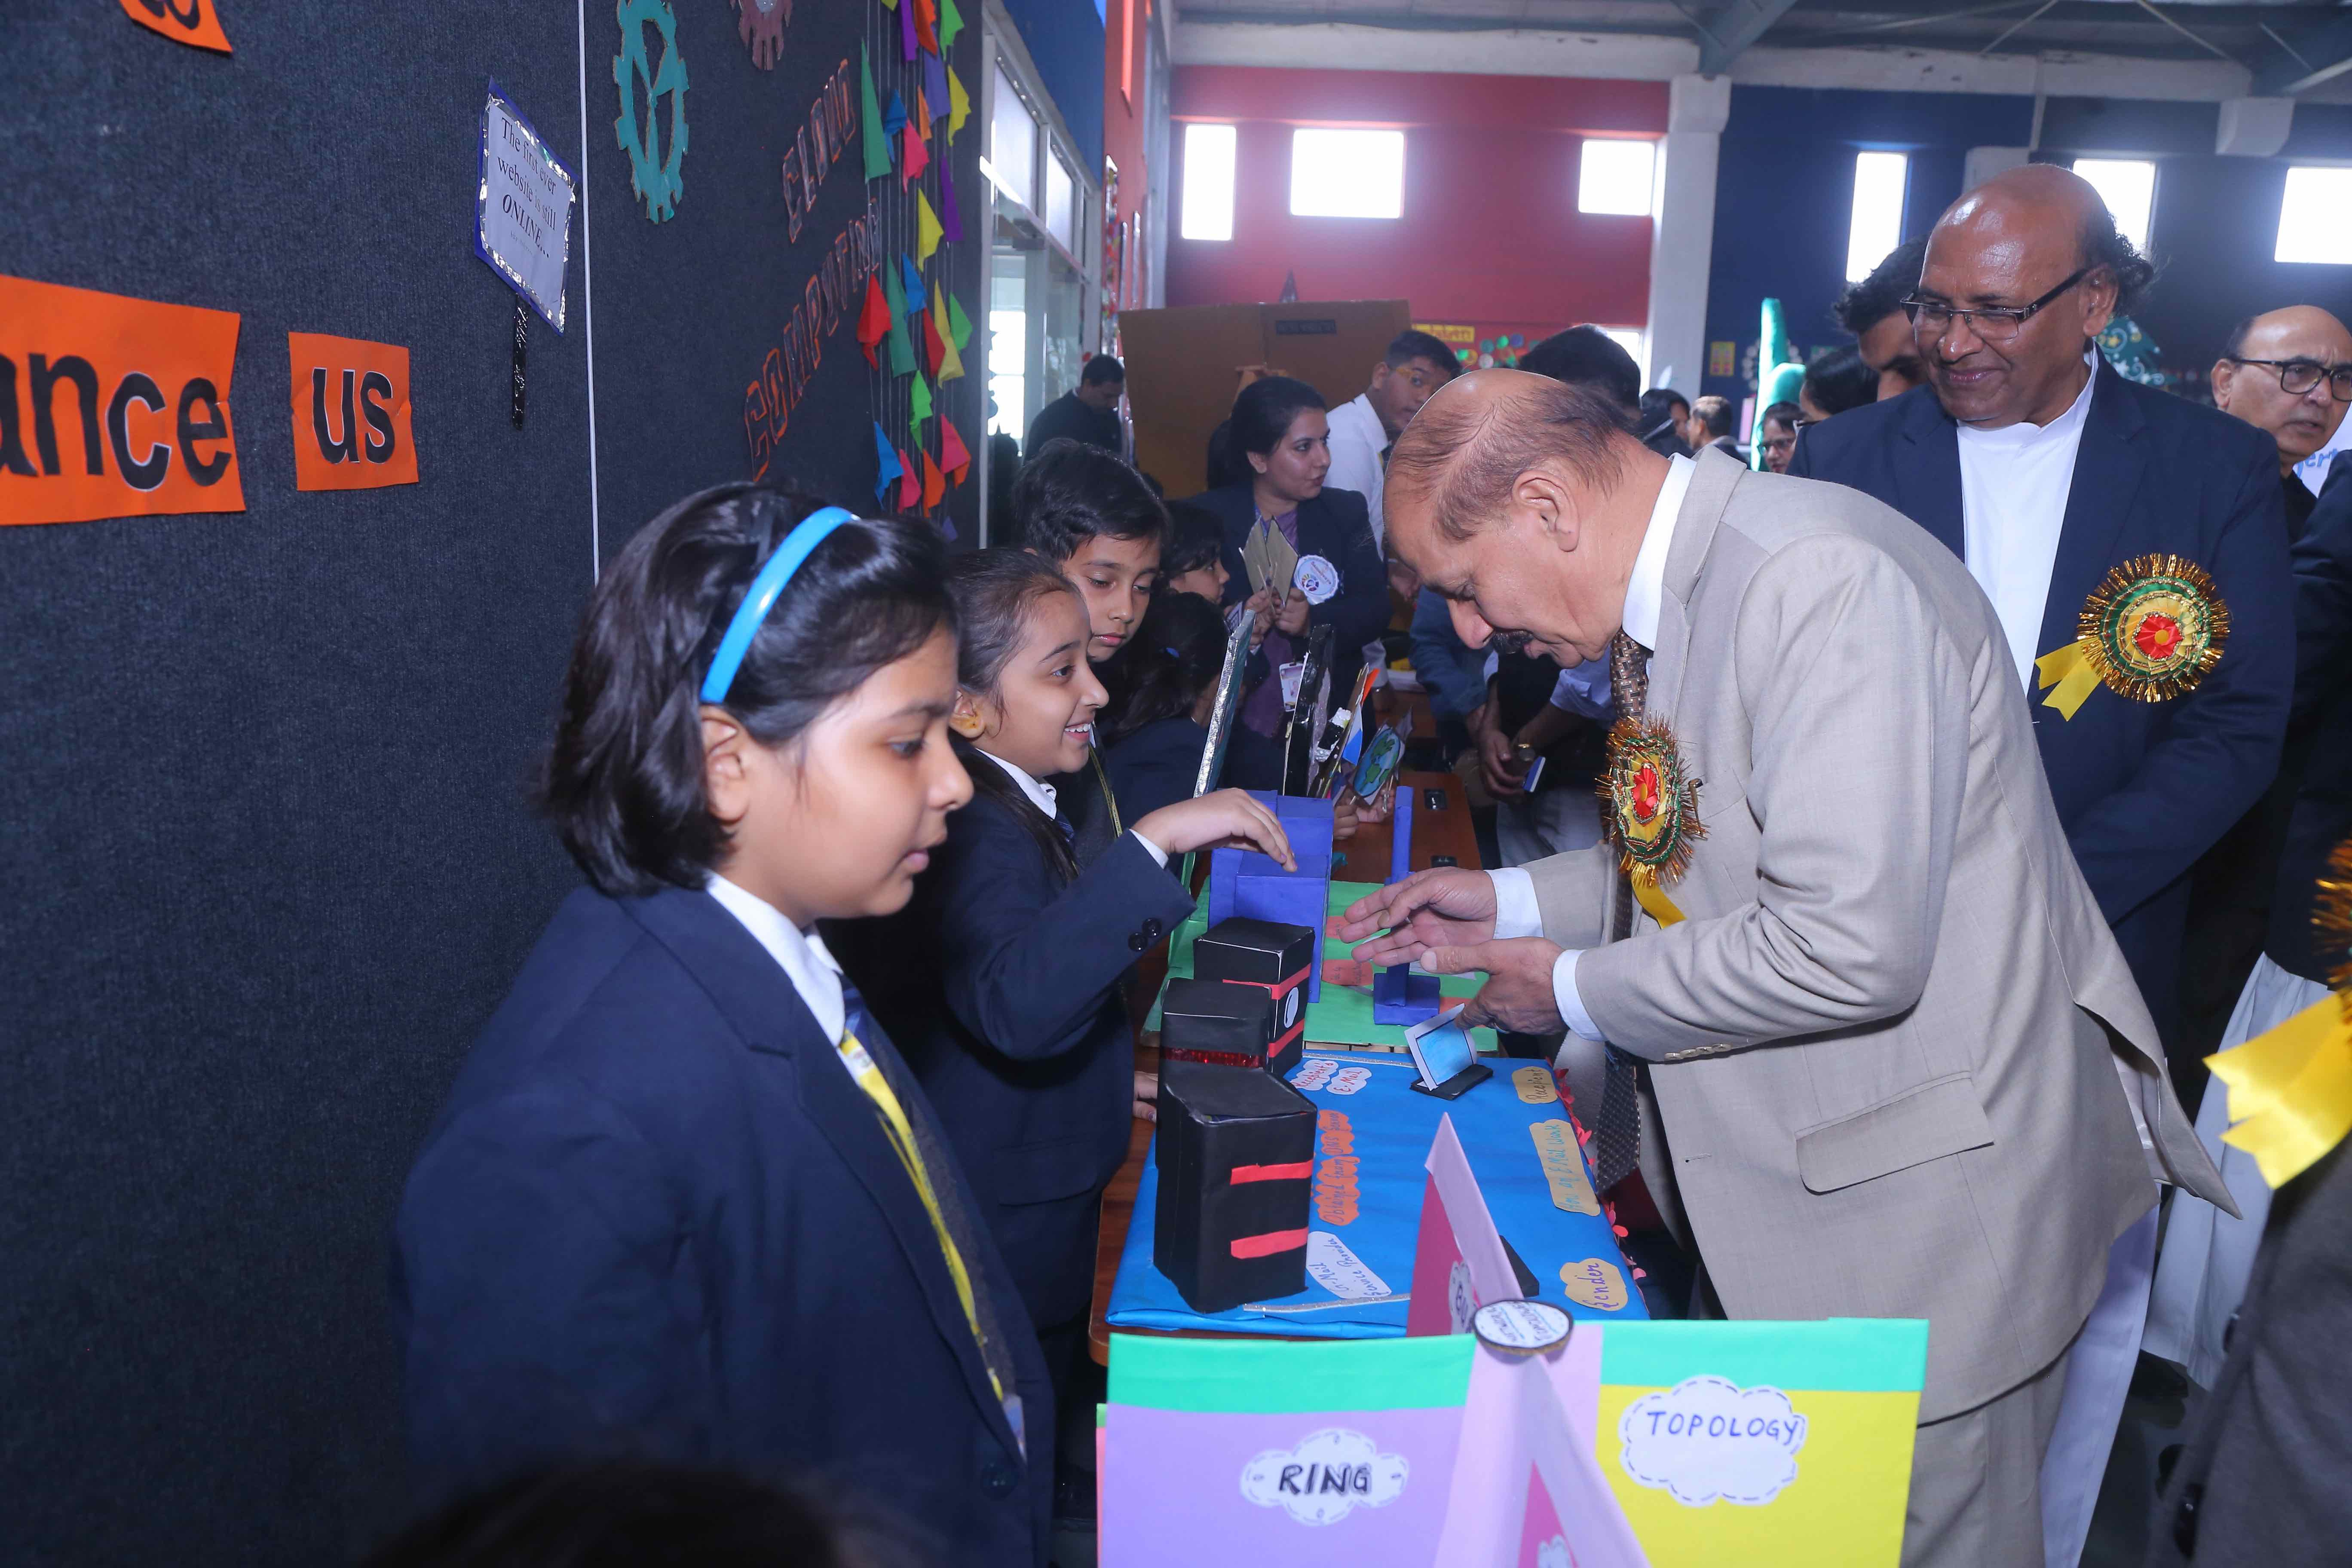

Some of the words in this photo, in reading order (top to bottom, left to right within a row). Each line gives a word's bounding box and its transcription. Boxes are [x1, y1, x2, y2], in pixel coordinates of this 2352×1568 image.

[502, 117, 520, 152] The
[524, 140, 538, 172] first
[540, 165, 556, 195] ever
[497, 157, 533, 202] website
[535, 190, 541, 213] is
[542, 204, 556, 230] still
[311, 367, 395, 465] us
[1647, 1411, 1799, 1446] TOPOLOGY
[1279, 1462, 1372, 1496] RING
